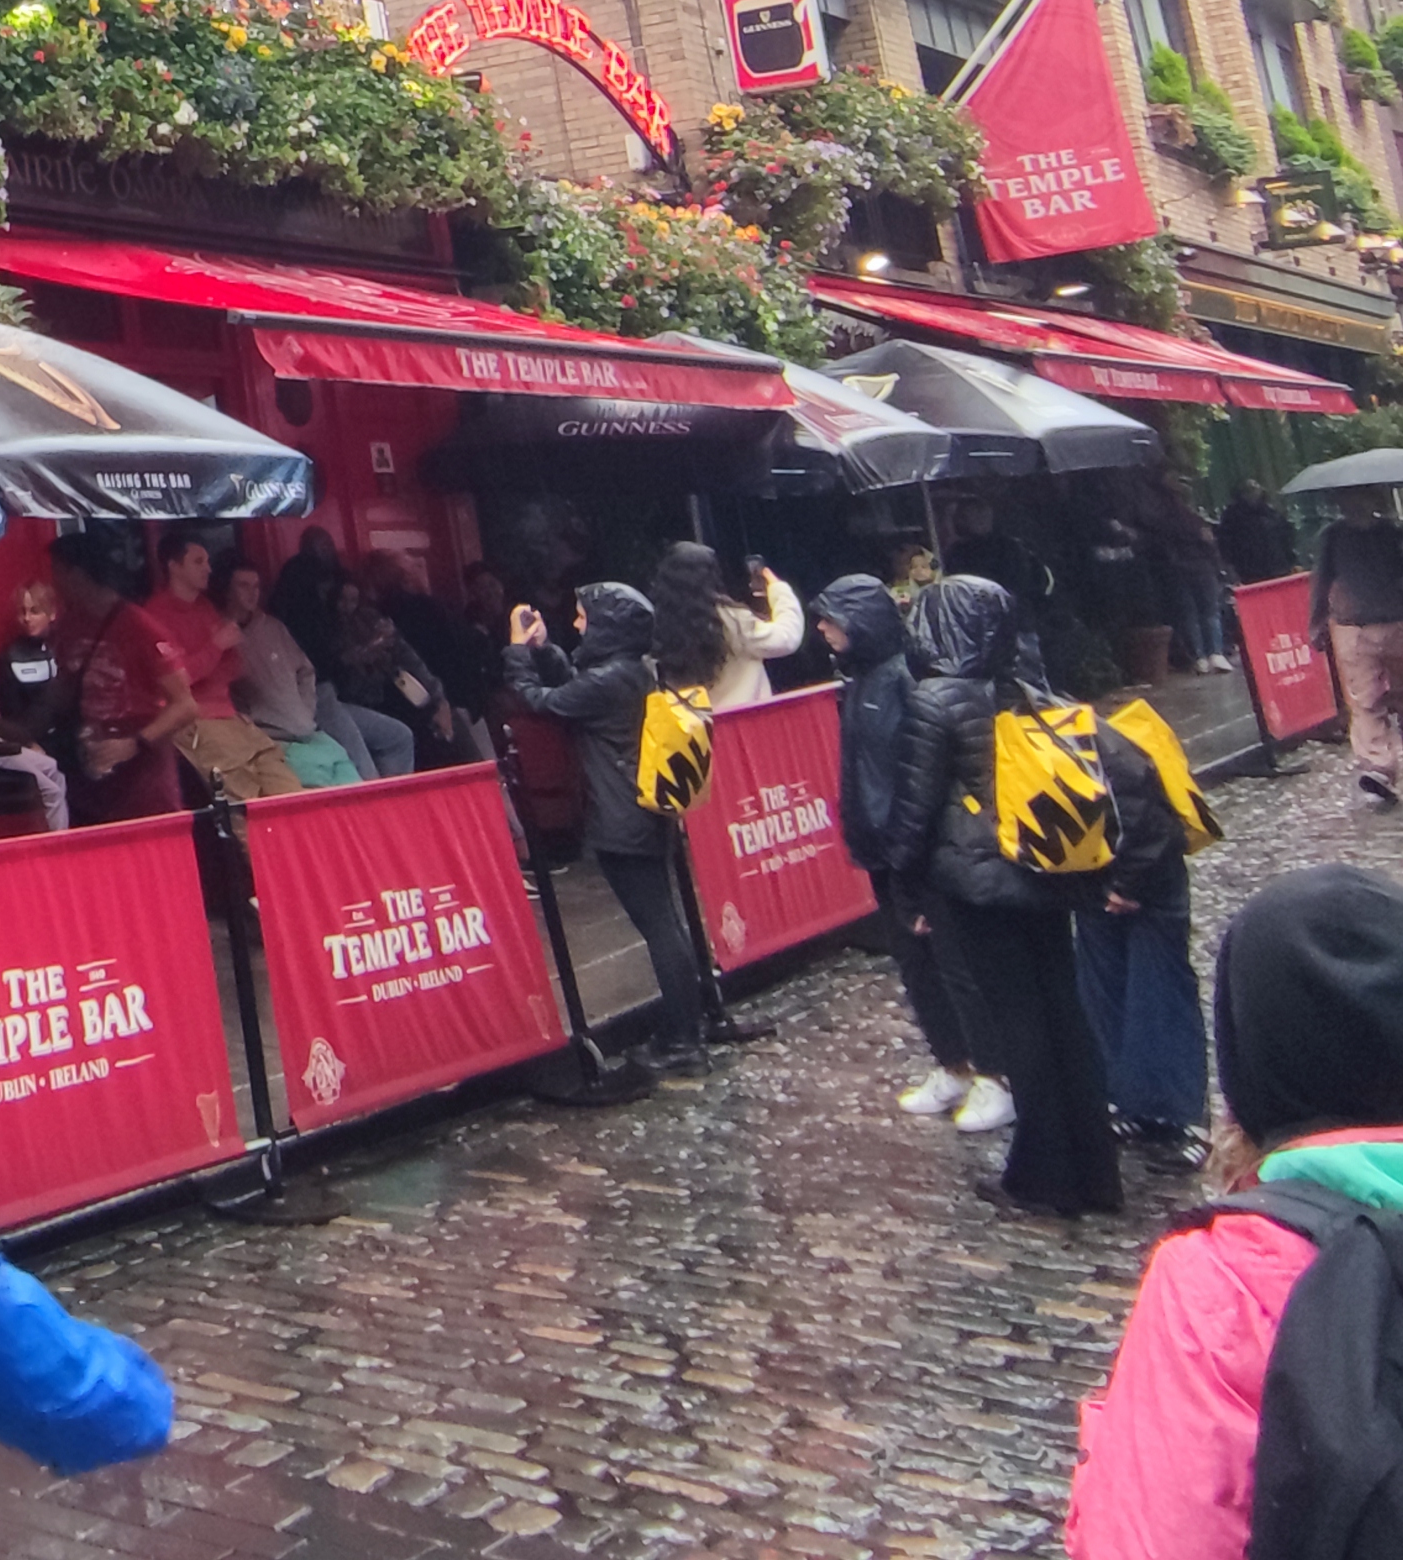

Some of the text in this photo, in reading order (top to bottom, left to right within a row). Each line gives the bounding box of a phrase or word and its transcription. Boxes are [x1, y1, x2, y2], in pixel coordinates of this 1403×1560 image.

[406, 2, 471, 77] THE
[602, 39, 671, 157] BAR
[985, 157, 1126, 199] TEMPLE
[1016, 149, 1077, 172] THE
[1021, 190, 1098, 219] BAR
[456, 347, 619, 387] THE TEMPLE BAR
[557, 419, 693, 437] GUINNESS
[96, 472, 192, 489] RAISING THE BAR
[759, 785, 790, 812] THE
[728, 810, 797, 859] TEMPLE
[794, 798, 833, 836] BAR
[381, 888, 426, 923] THE
[324, 907, 491, 980] TEMPLE BAR
[2, 965, 67, 1008] THE
[371, 965, 463, 1002] DUBLIN IRELAND
[79, 984, 153, 1045] BAR
[49, 1057, 110, 1090] IRELAND
